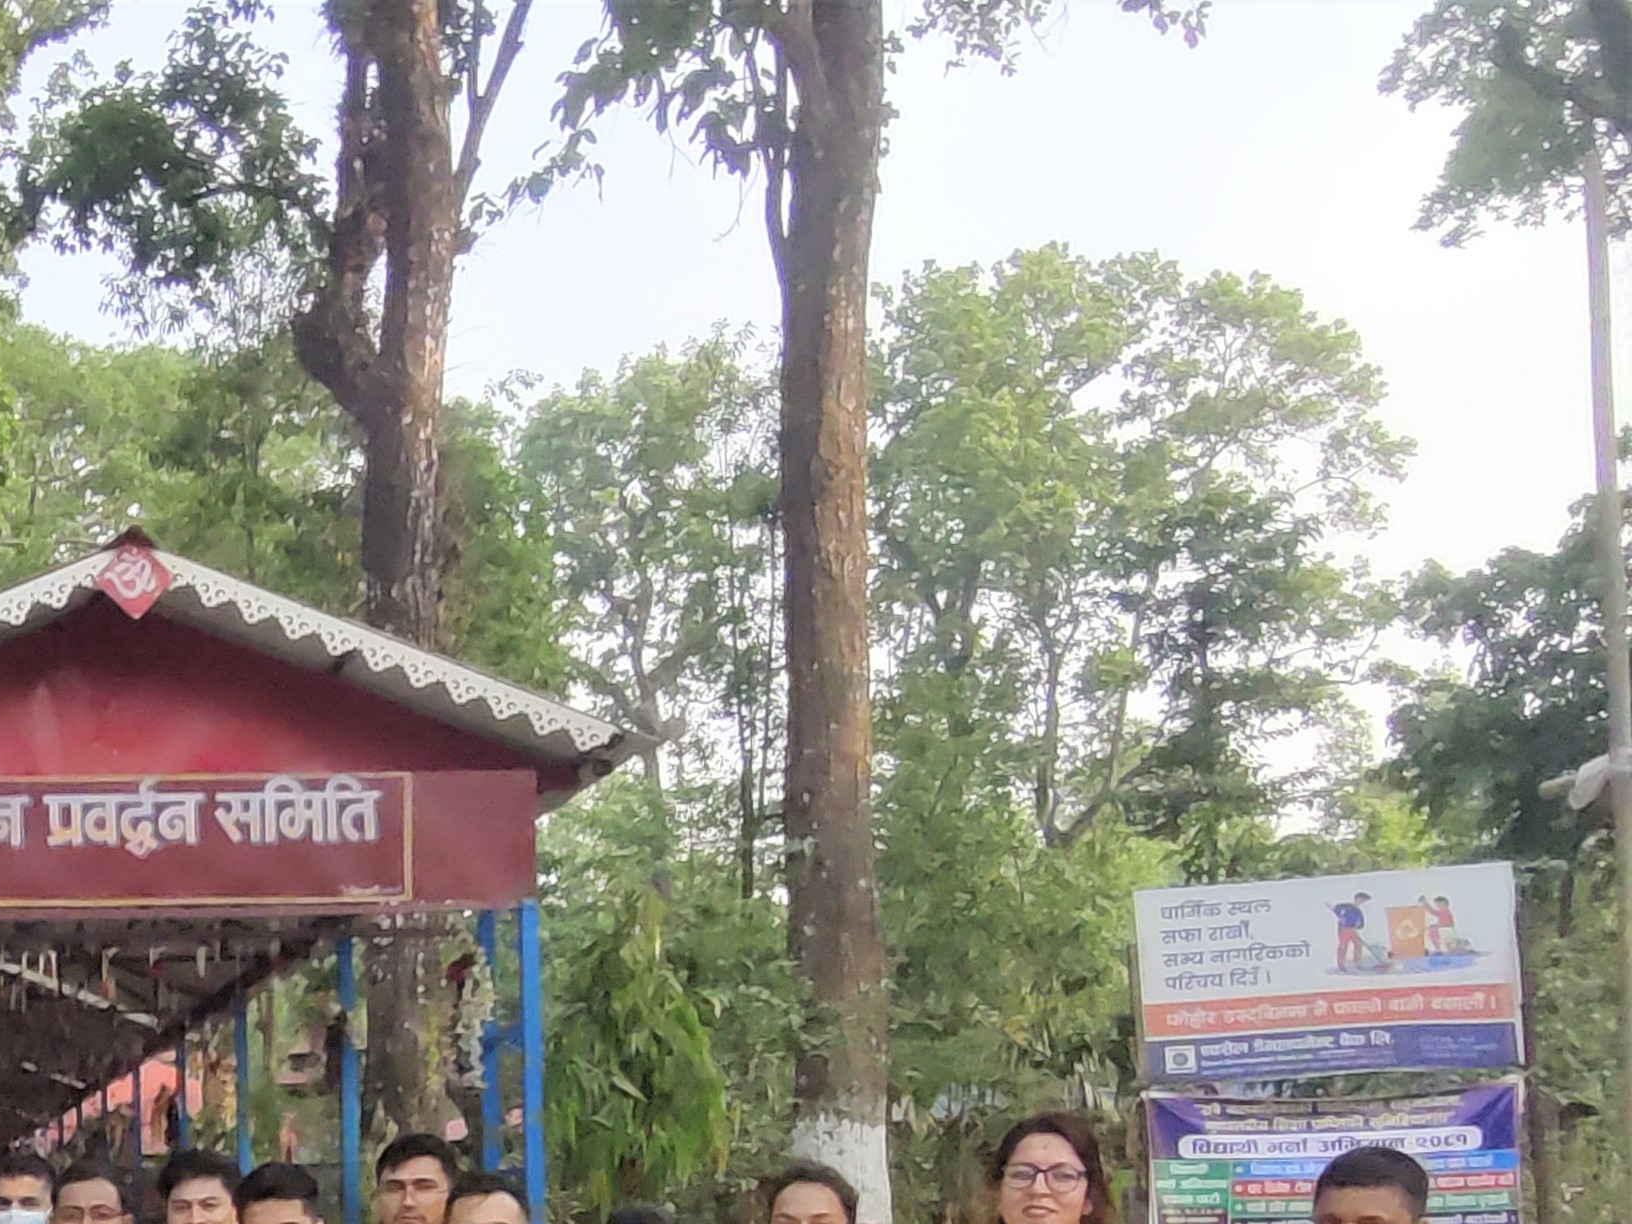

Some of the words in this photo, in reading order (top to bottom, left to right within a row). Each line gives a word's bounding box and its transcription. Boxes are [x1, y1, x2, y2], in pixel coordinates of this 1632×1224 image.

[214, 775, 383, 845] समिति
[1161, 900, 1222, 921] धार्मिक
[1161, 928, 1202, 944] सफा
[1163, 952, 1203, 968] सभ्य
[1210, 940, 1311, 964] नागरिकको
[1164, 971, 1224, 991] परिचय
